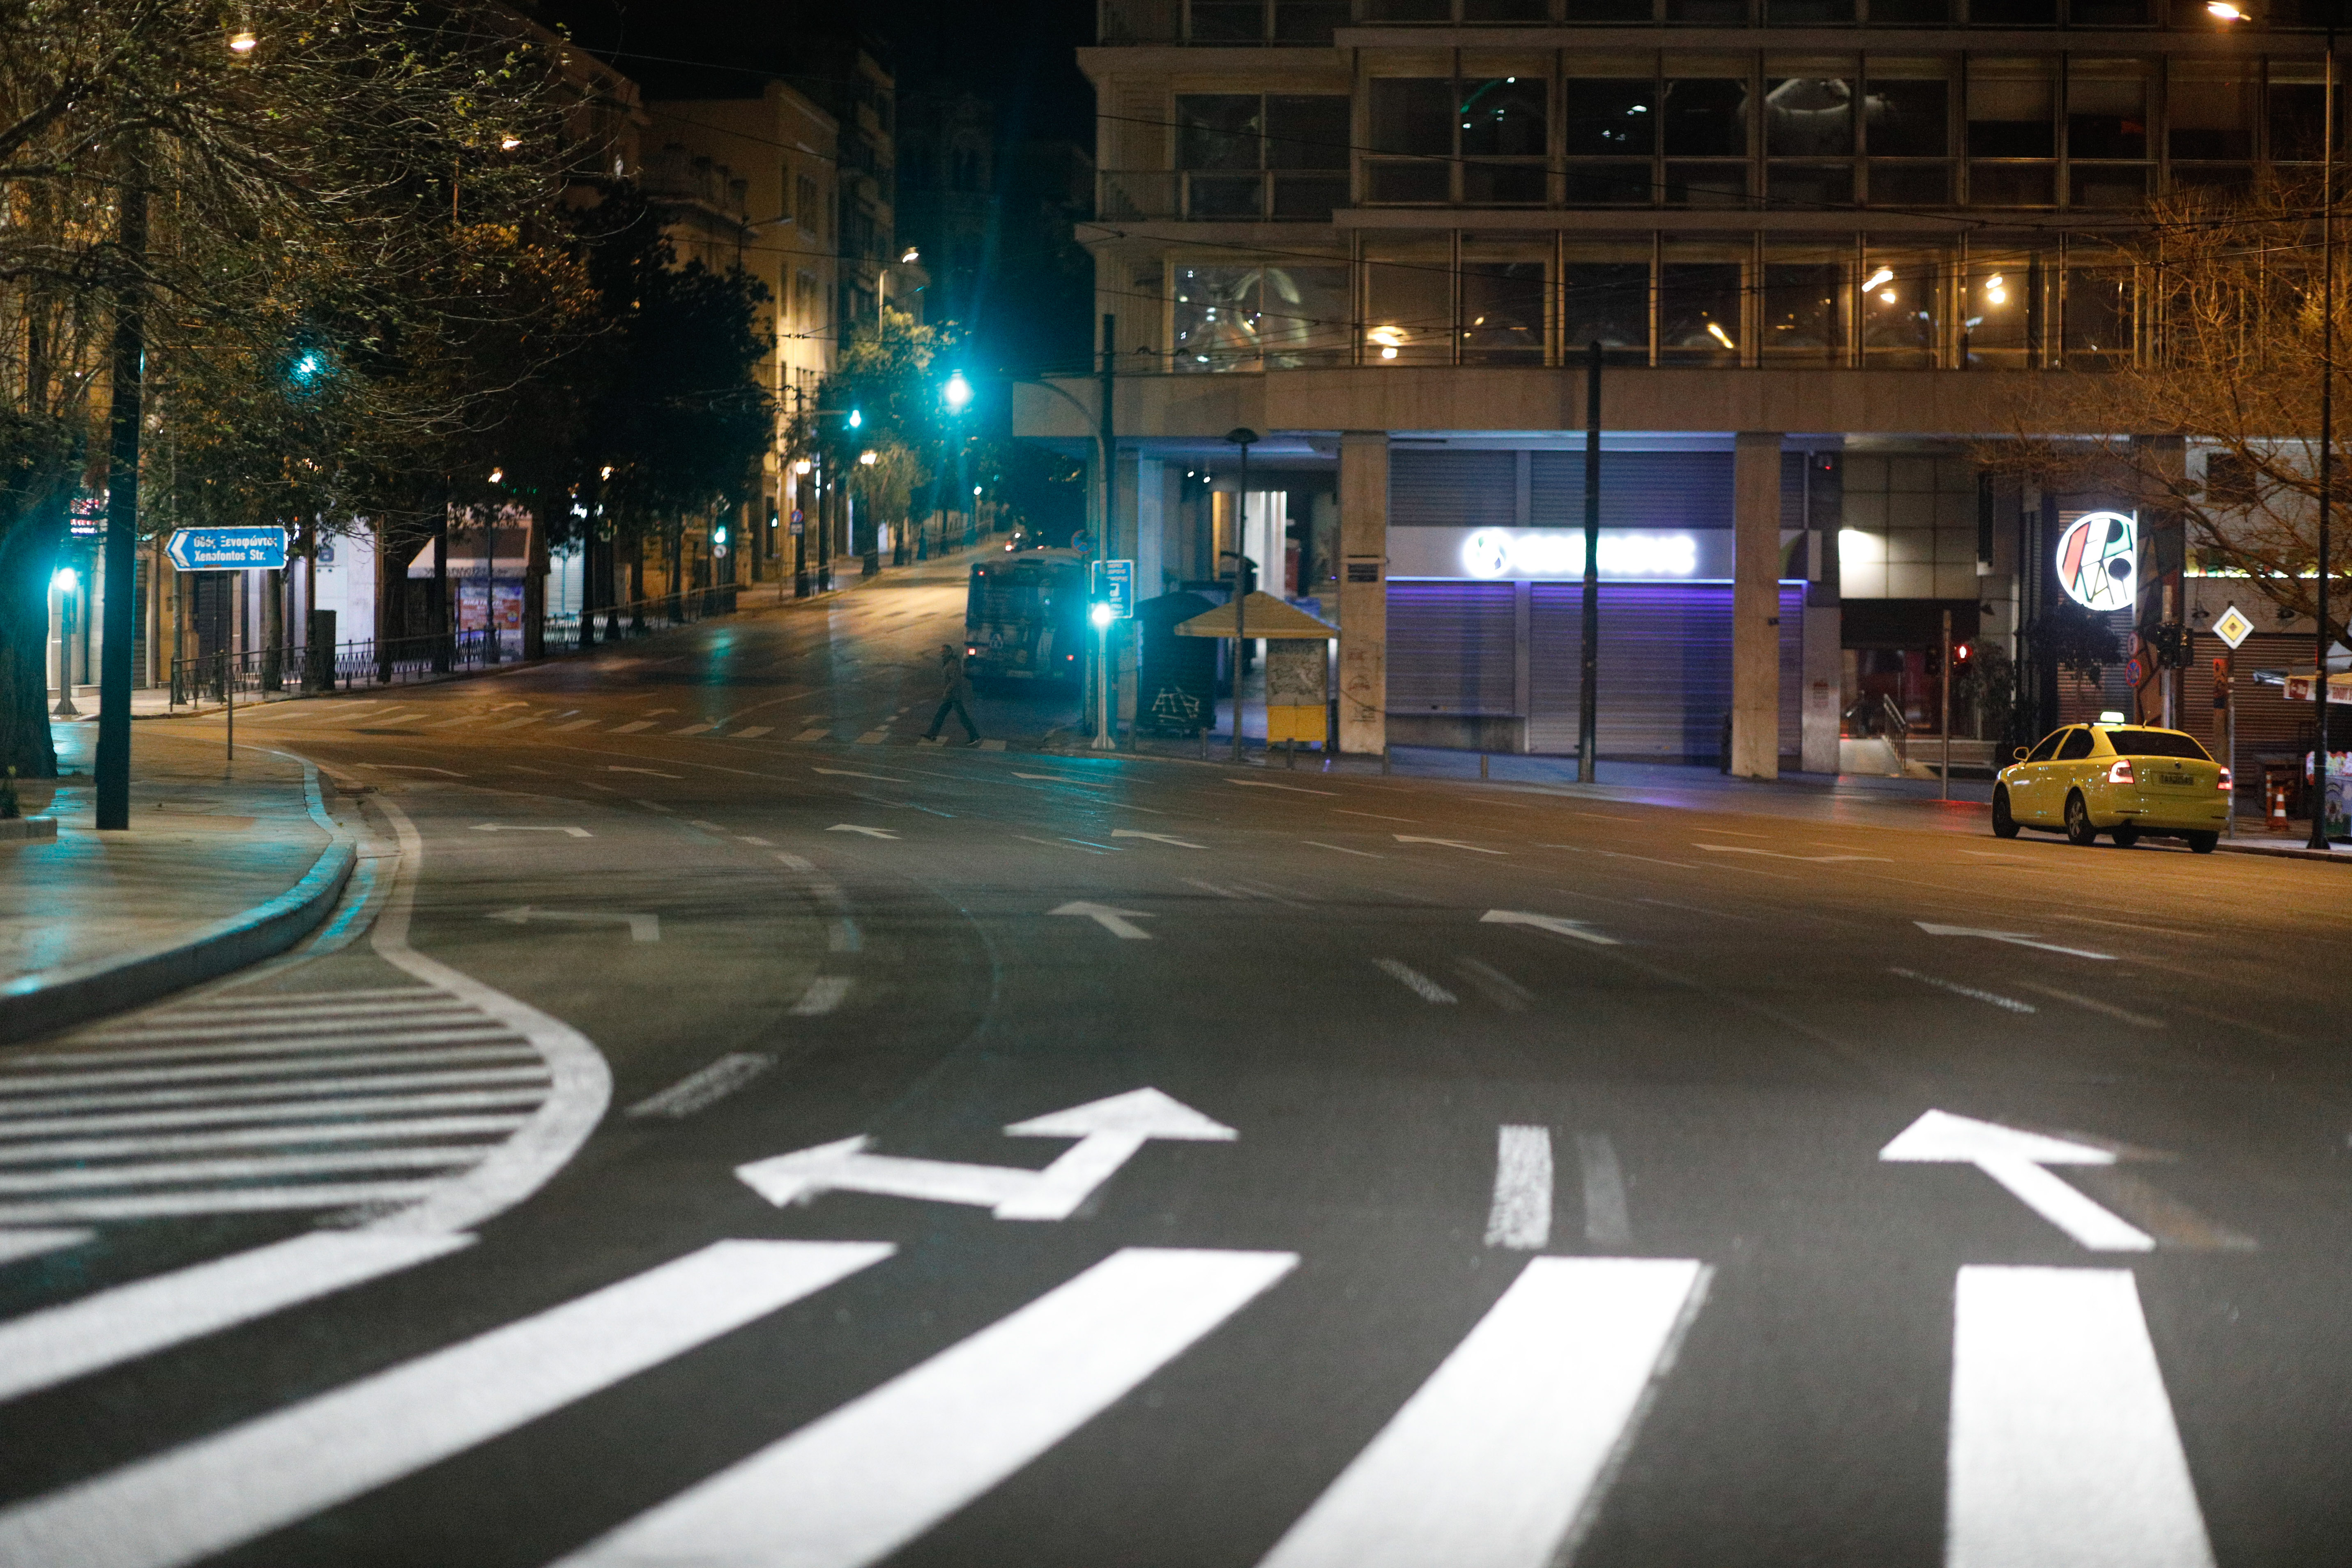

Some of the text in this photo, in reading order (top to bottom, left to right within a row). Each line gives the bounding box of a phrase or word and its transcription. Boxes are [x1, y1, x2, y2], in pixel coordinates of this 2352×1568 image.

[193, 535, 278, 549] Οδός Ξενοφώντος
[194, 549, 266, 562] Xenofontos Str.
